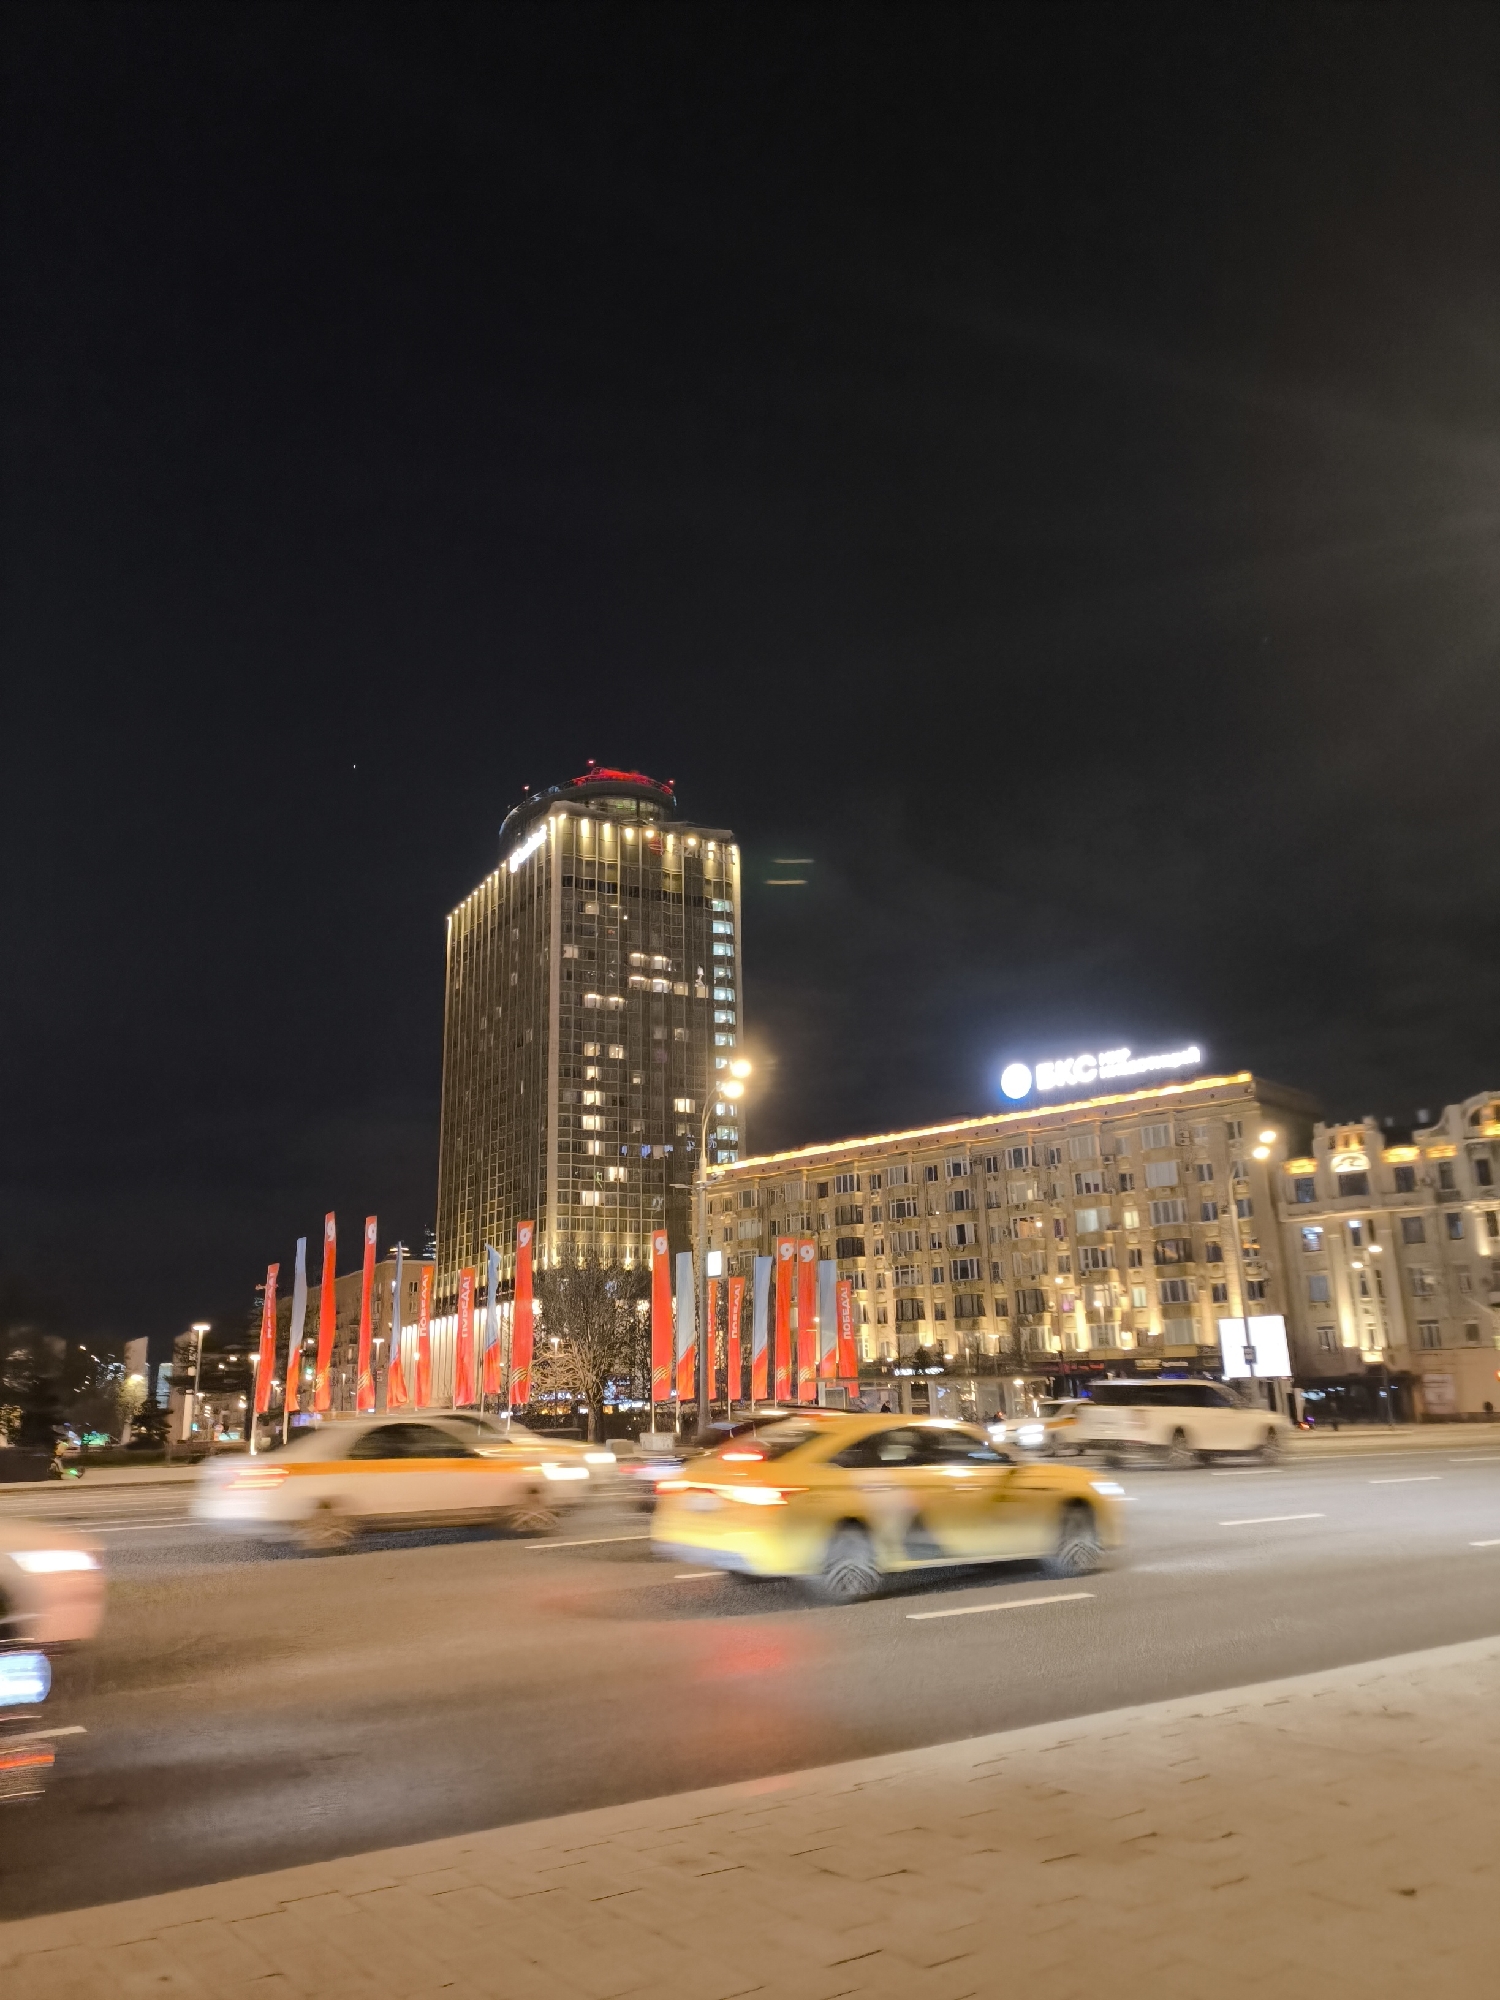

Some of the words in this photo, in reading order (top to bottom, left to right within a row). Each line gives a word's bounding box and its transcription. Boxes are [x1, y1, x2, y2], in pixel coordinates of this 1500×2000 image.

[326, 1220, 335, 1242] 9
[367, 1223, 377, 1245] 9
[519, 1227, 531, 1248] 9
[655, 1236, 667, 1256] 9
[780, 1243, 795, 1261] 9
[800, 1244, 815, 1263] 9
[840, 1287, 851, 1340] ПОБЕДА!
